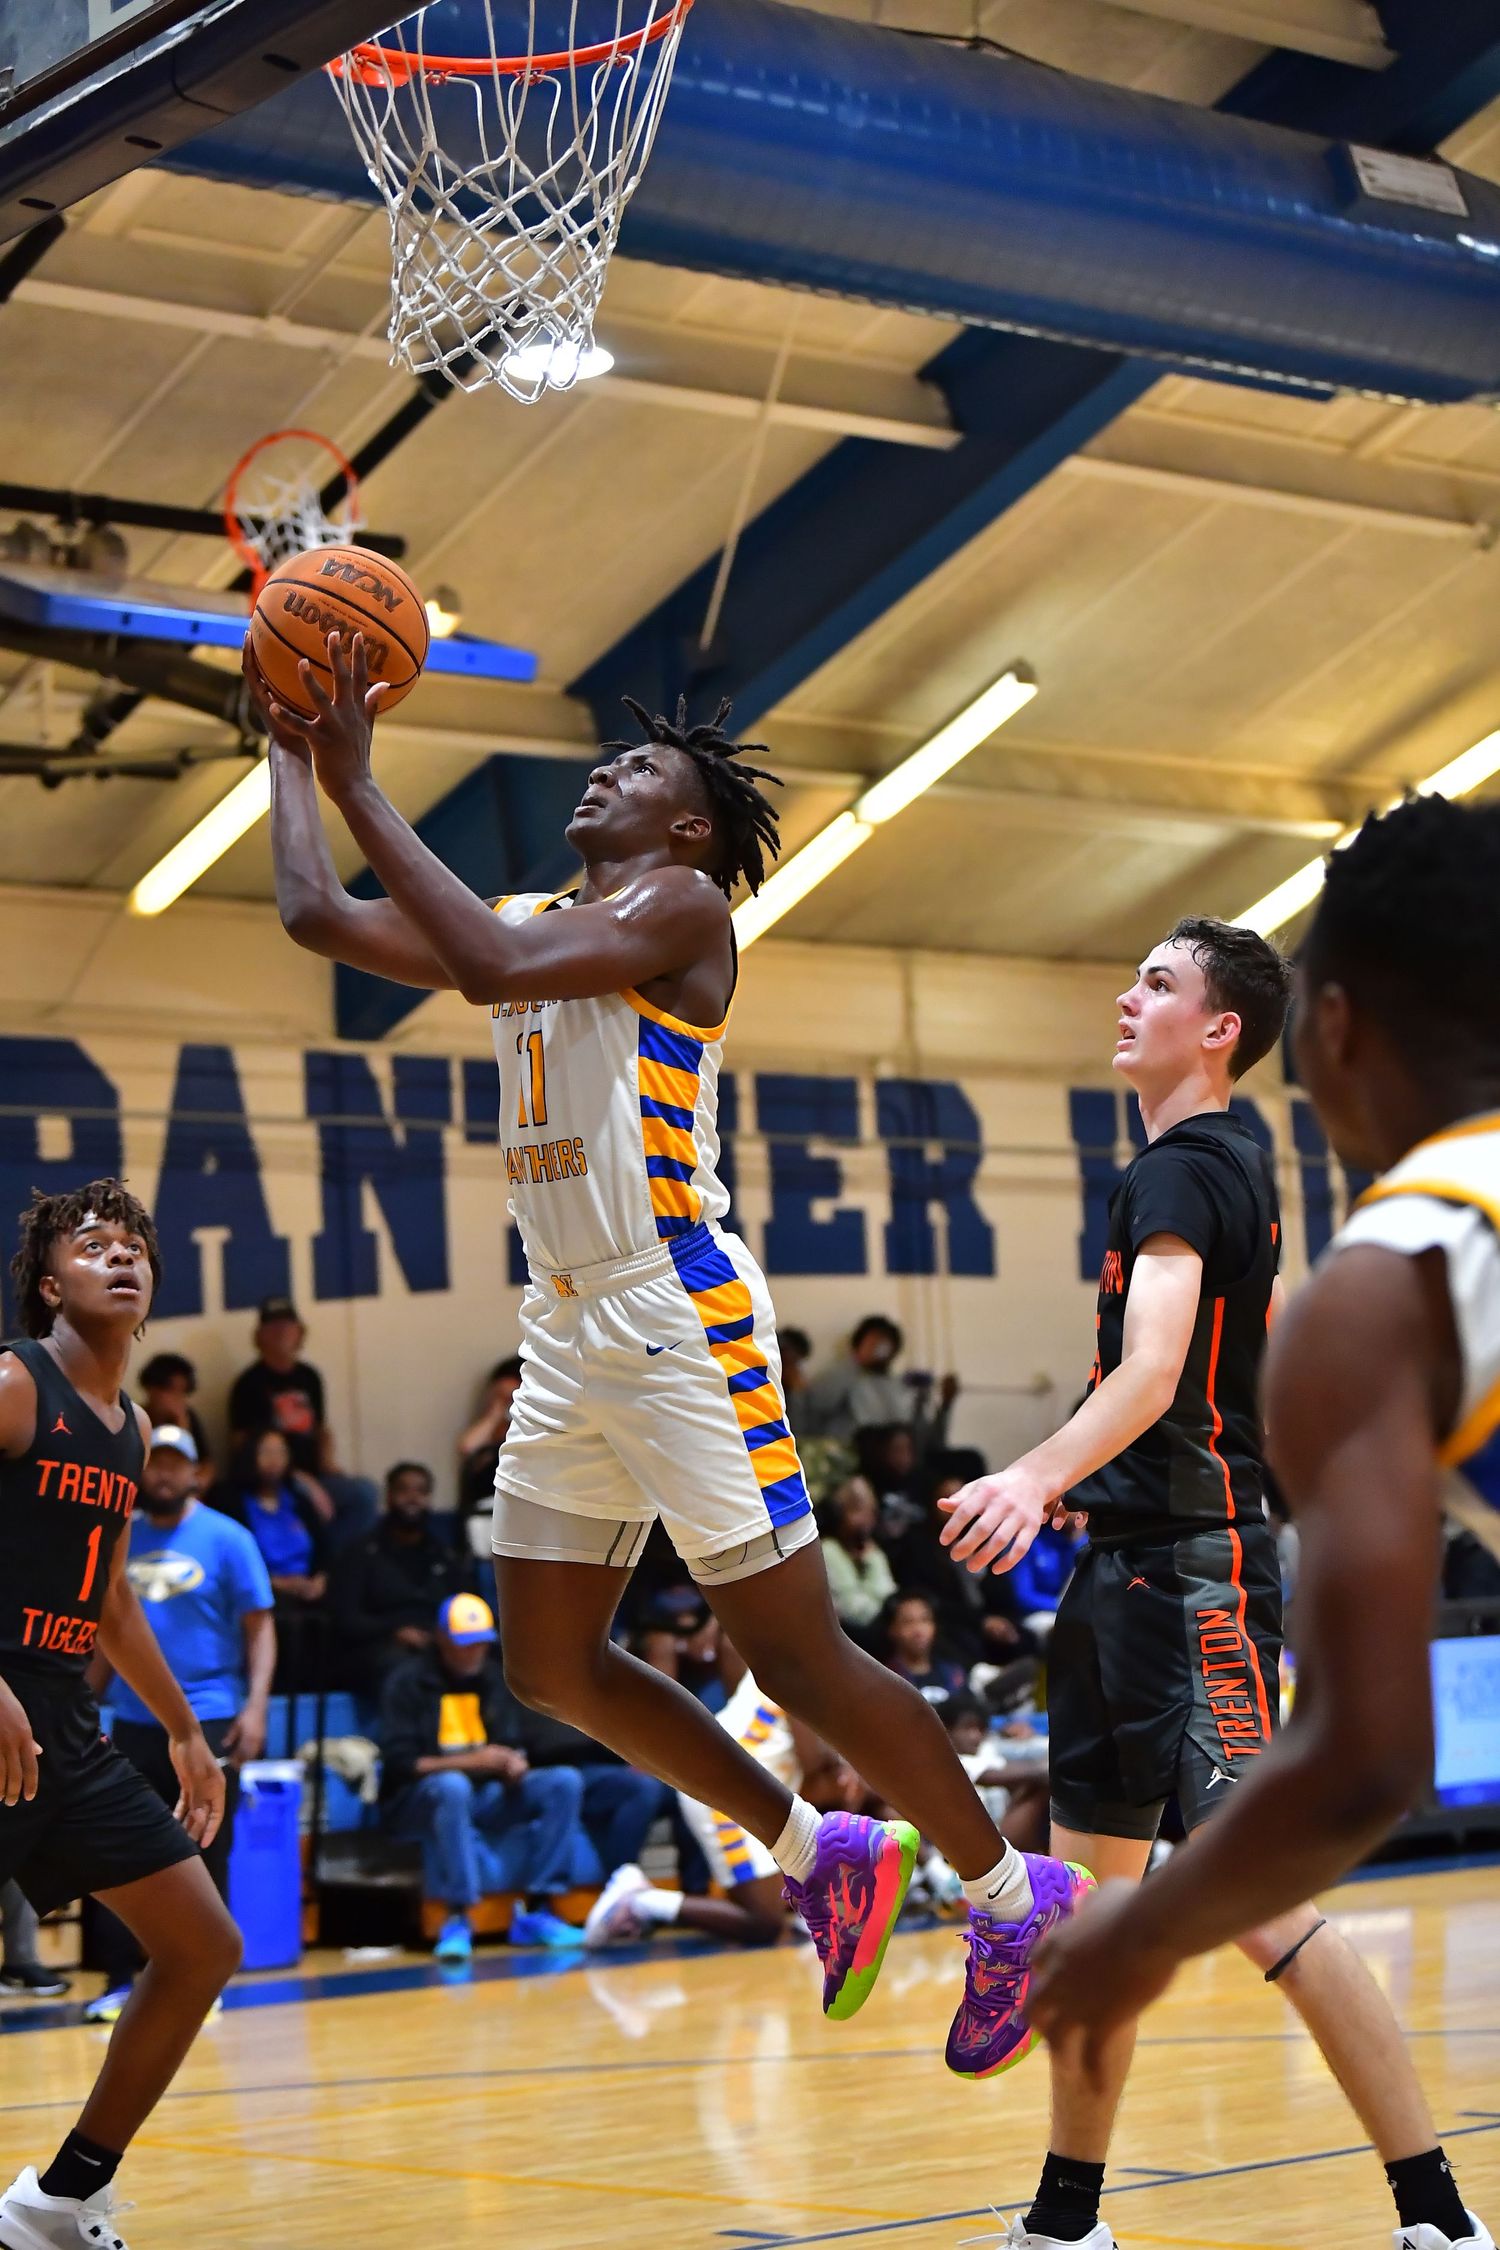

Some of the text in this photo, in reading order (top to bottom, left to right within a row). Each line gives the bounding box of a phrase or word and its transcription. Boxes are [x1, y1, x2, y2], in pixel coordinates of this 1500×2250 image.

[320, 557, 403, 613] NCAA
[517, 1029, 548, 1128] 11
[0, 1036, 995, 1340] PANER
[502, 1137, 588, 1185] ANTHERS
[36, 1459, 138, 1518] TRENTO
[78, 1525, 103, 1601] 1
[1196, 1607, 1263, 1761] TRENTON
